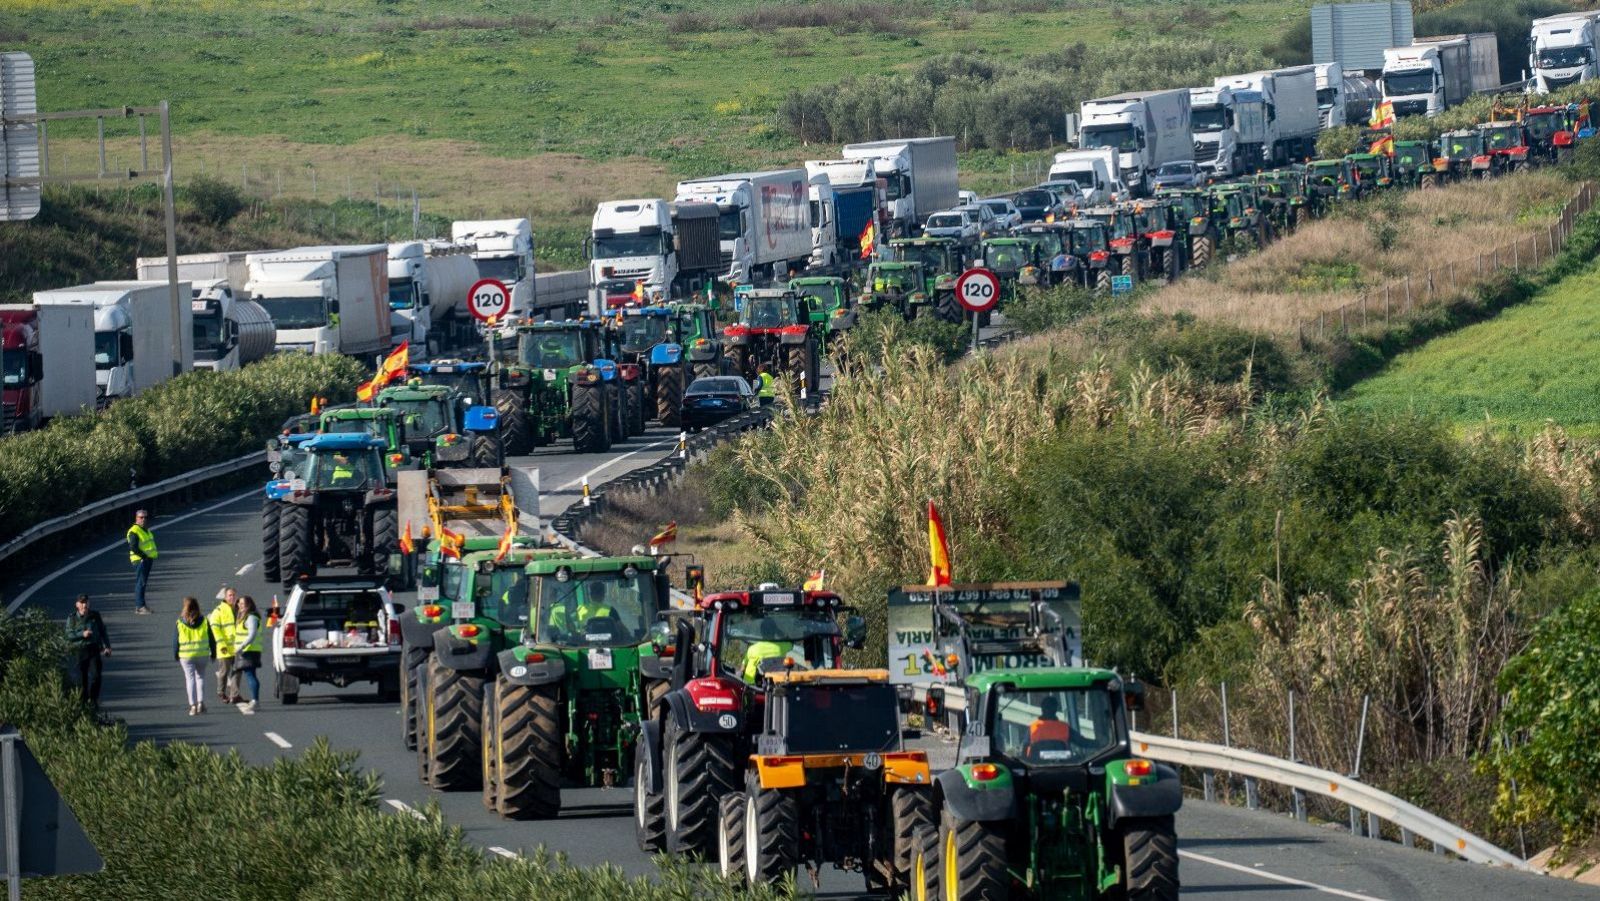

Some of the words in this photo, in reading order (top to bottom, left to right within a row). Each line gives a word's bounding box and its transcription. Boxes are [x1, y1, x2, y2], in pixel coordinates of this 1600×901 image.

[964, 283, 993, 298] 120
[474, 293, 504, 308] 120
[722, 716, 733, 727] 50
[968, 722, 983, 737] 40
[865, 754, 878, 768] 40
